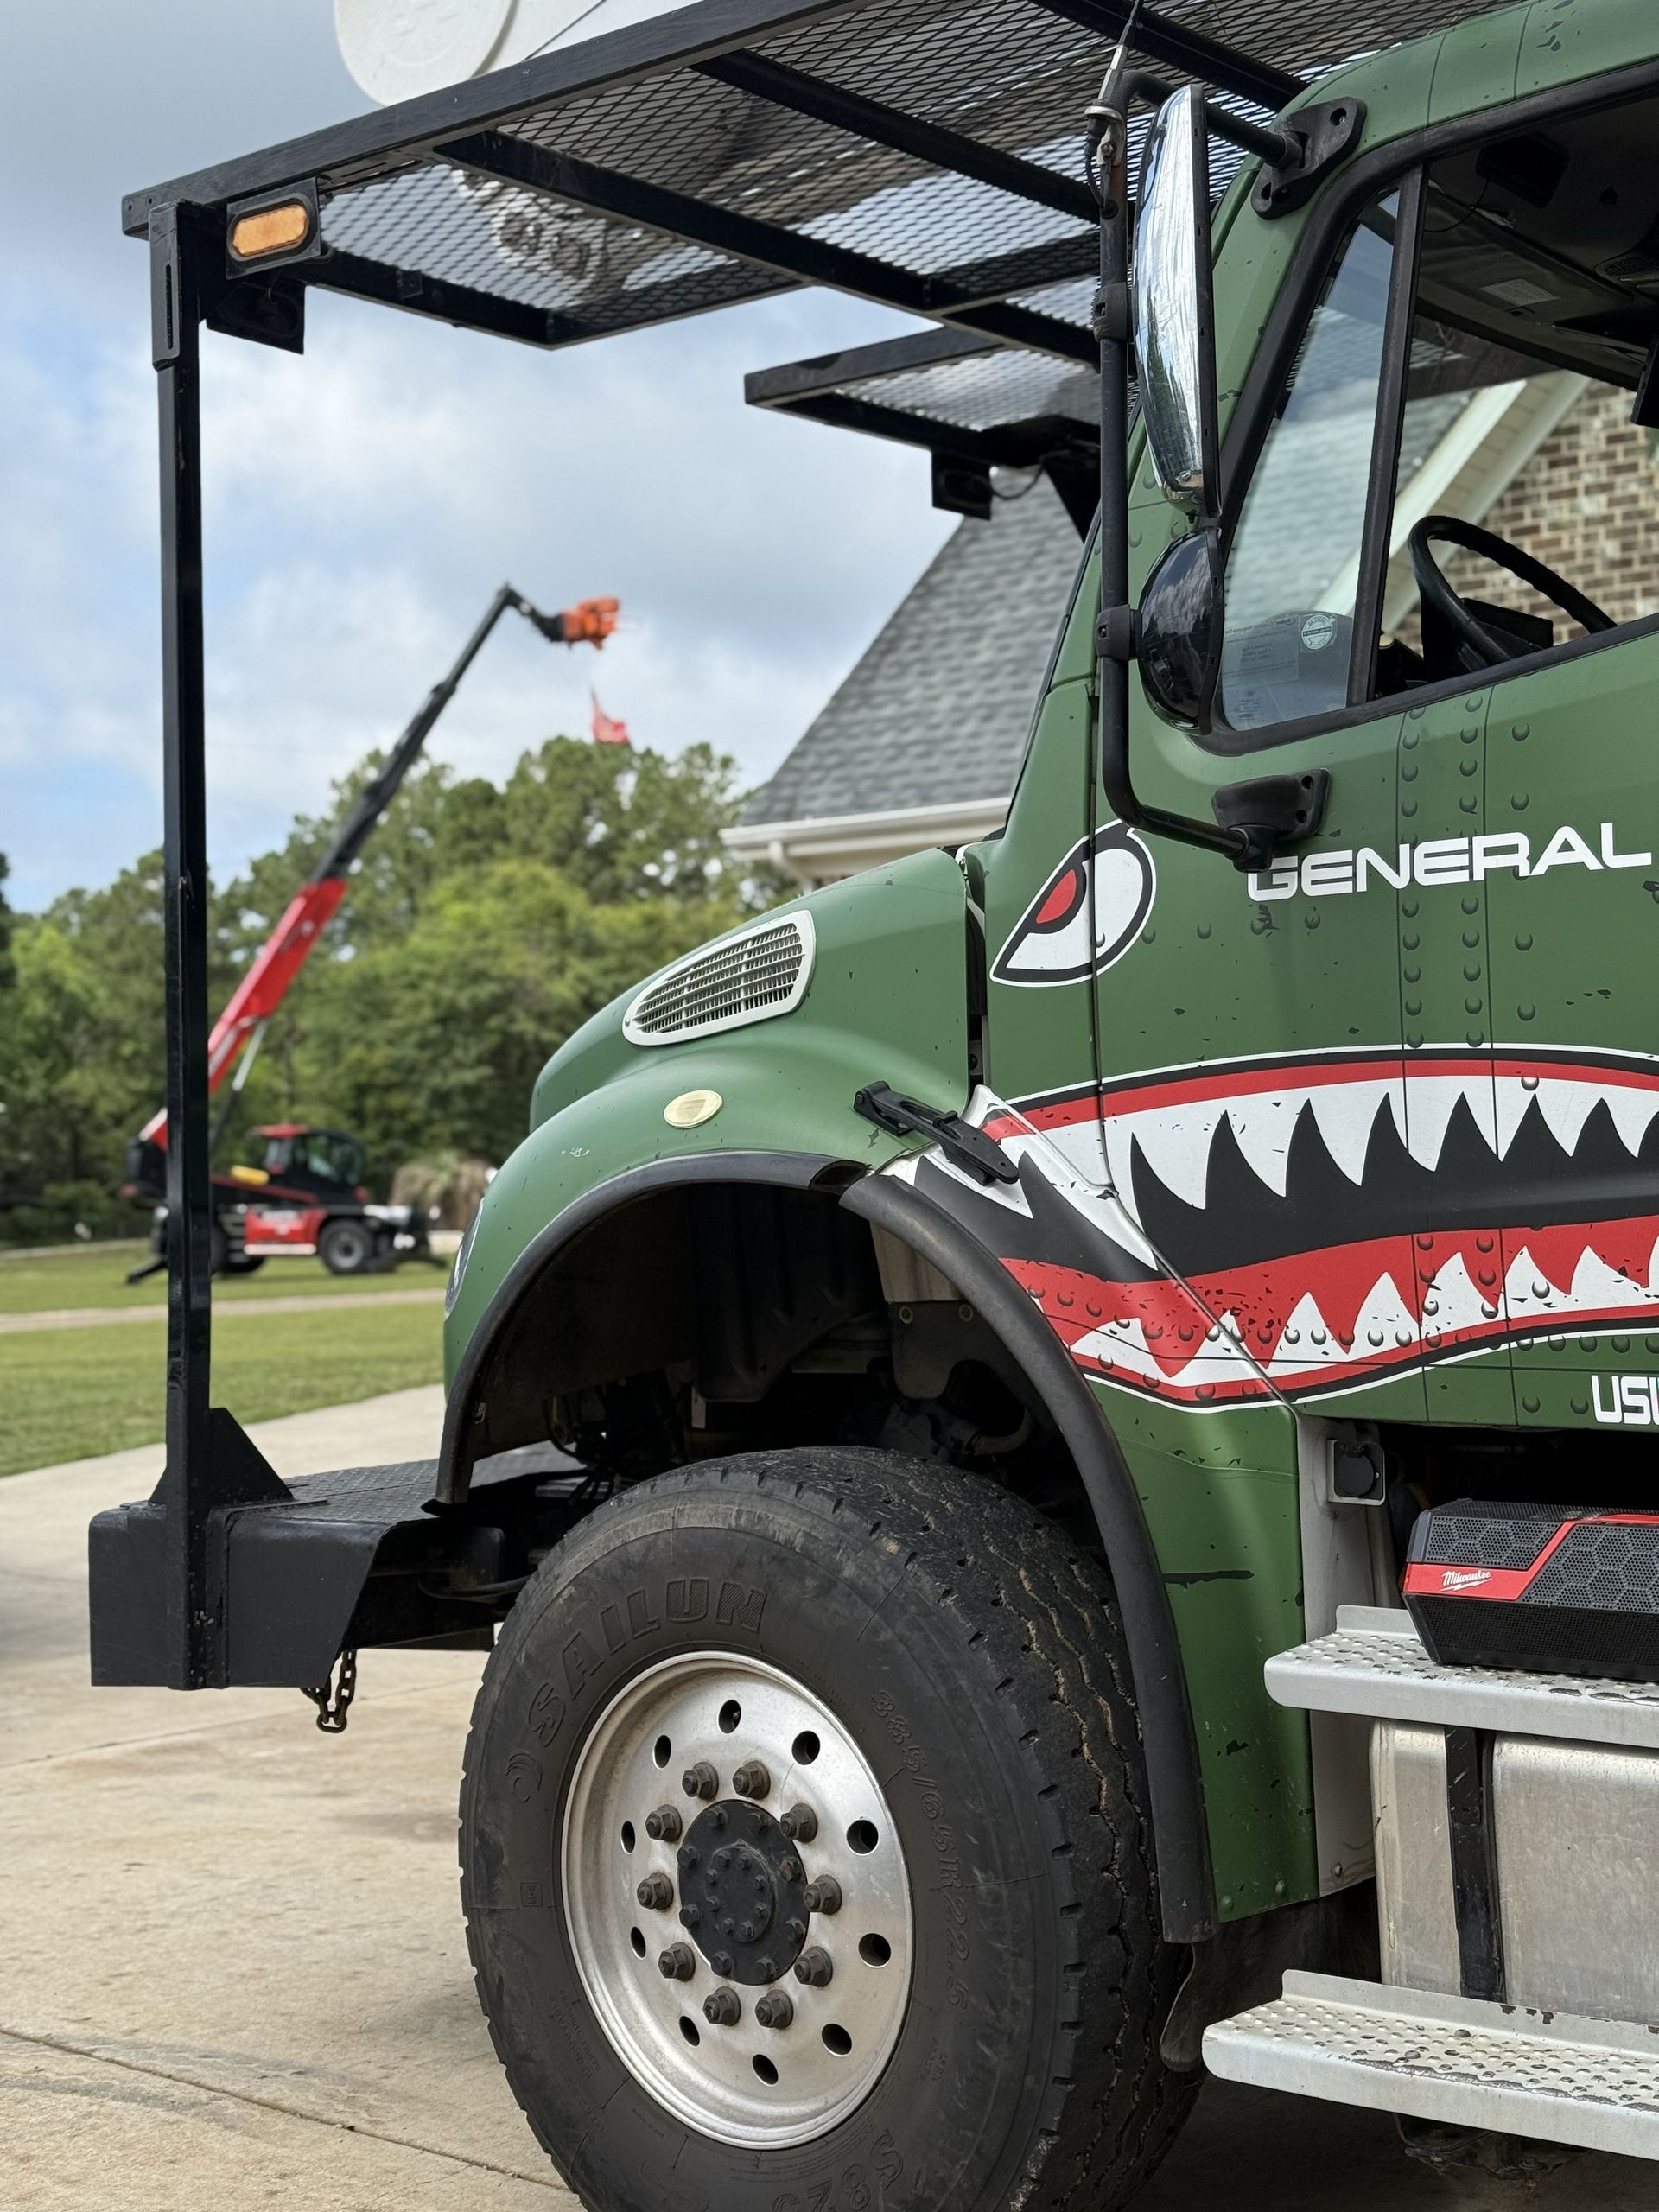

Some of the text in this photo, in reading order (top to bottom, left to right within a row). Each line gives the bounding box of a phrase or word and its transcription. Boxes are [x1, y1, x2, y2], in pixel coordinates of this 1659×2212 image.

[1247, 822, 1652, 902] GENERAL
[1591, 1375, 1659, 1426] US
[1442, 1569, 1491, 1585] Milwaukee
[529, 1578, 767, 1747] SAILUN
